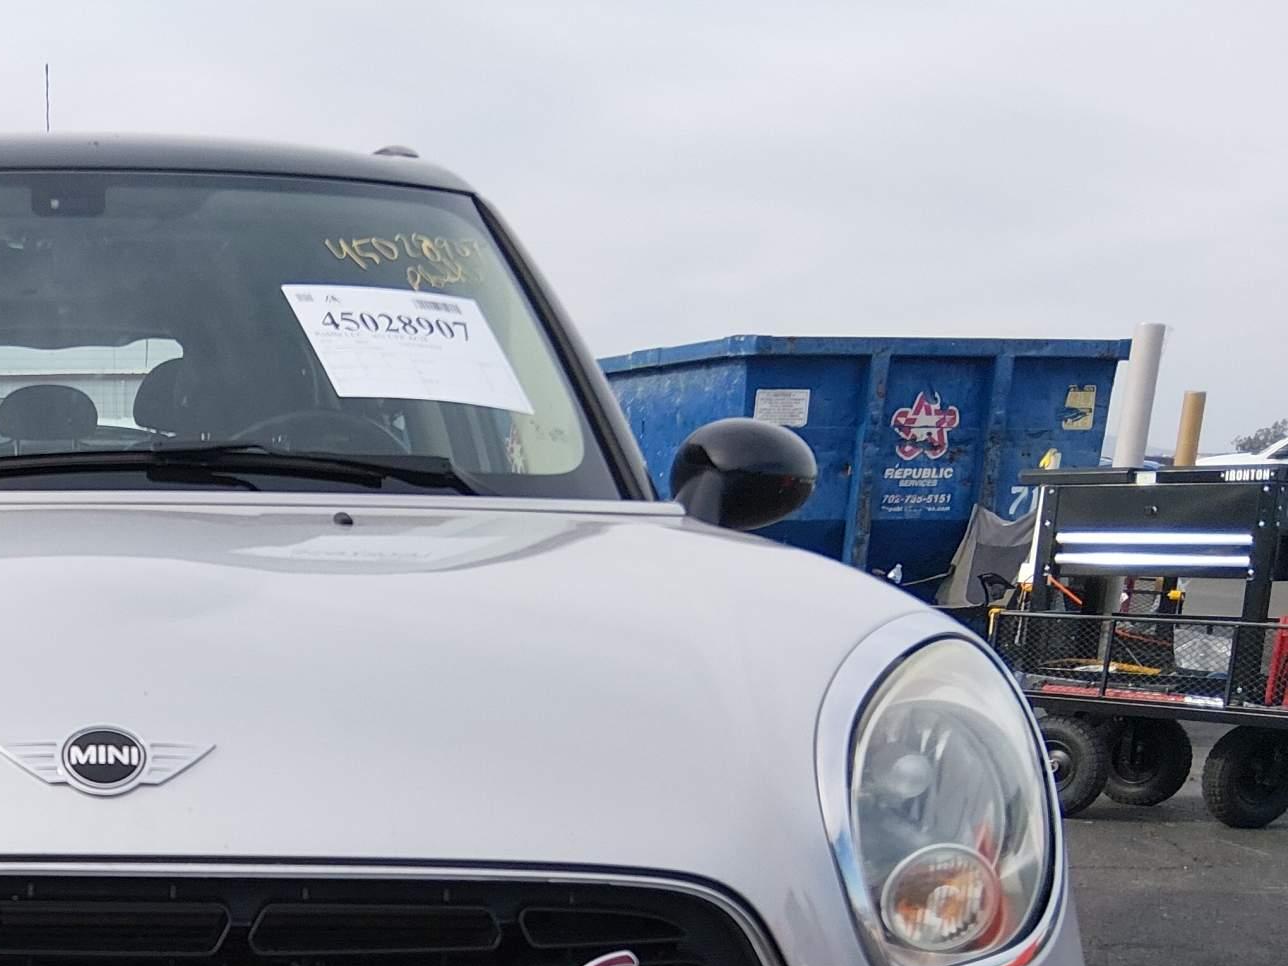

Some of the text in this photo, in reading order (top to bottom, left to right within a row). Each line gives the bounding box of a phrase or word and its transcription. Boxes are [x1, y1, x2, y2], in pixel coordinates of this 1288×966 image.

[321, 311, 468, 341] 45028907
[884, 467, 954, 479] REPUBLIC
[1224, 469, 1270, 481] IRONTON
[898, 479, 938, 487] SERVICES
[69, 744, 139, 766] MINI
